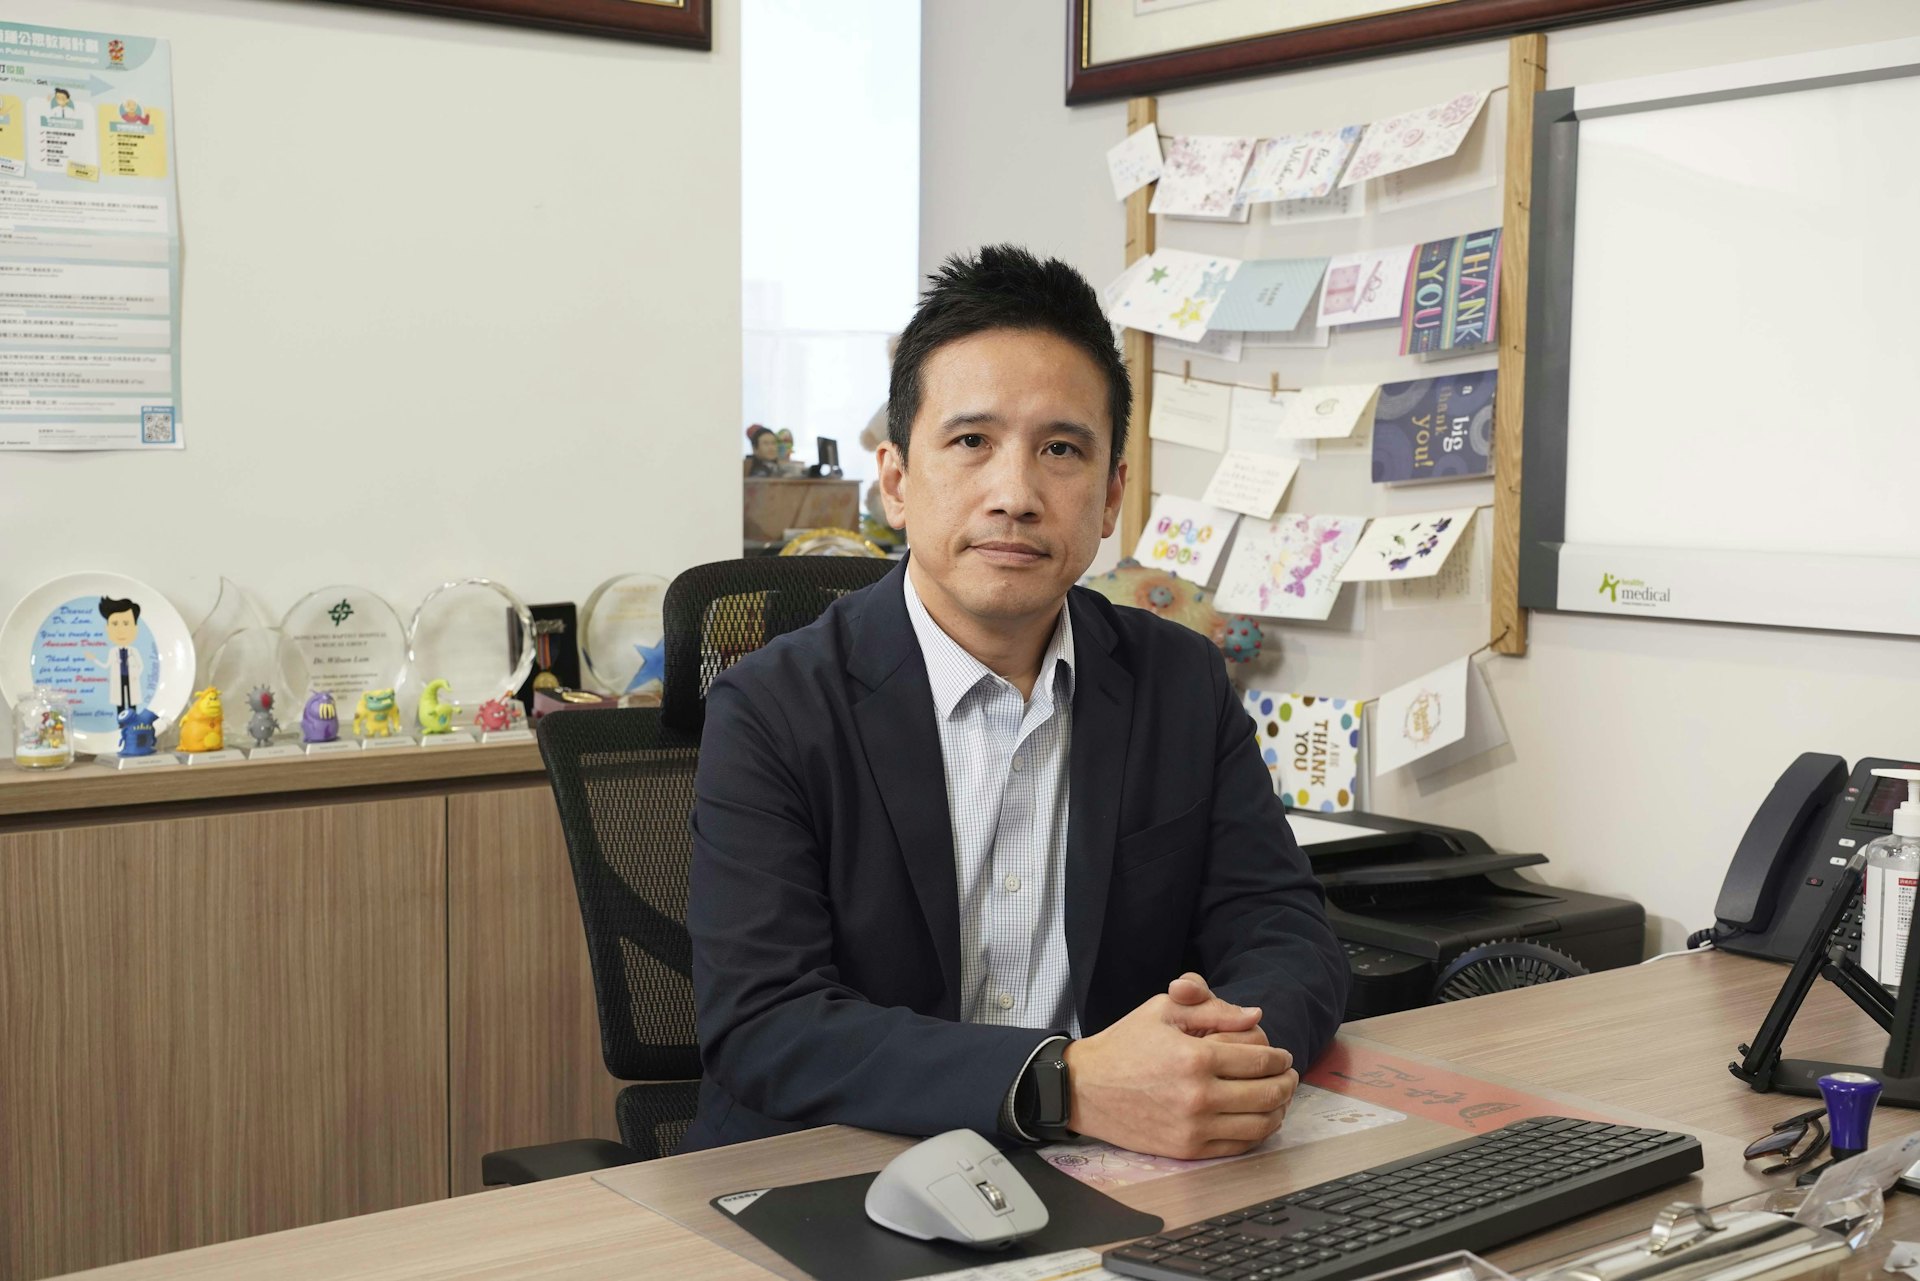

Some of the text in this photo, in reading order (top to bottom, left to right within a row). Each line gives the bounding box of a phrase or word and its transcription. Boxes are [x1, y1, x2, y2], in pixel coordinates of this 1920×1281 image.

[1414, 260, 1447, 329] YOU
[1454, 231, 1494, 343] THANK
[1434, 386, 1454, 436] thank
[1443, 385, 1473, 453] a big
[1411, 414, 1434, 468] you!
[1622, 587, 1671, 602] medical
[39, 665, 51, 674] for
[45, 654, 85, 664] Thank you
[1294, 731, 1309, 771] YOU
[1310, 720, 1329, 786] THANK
